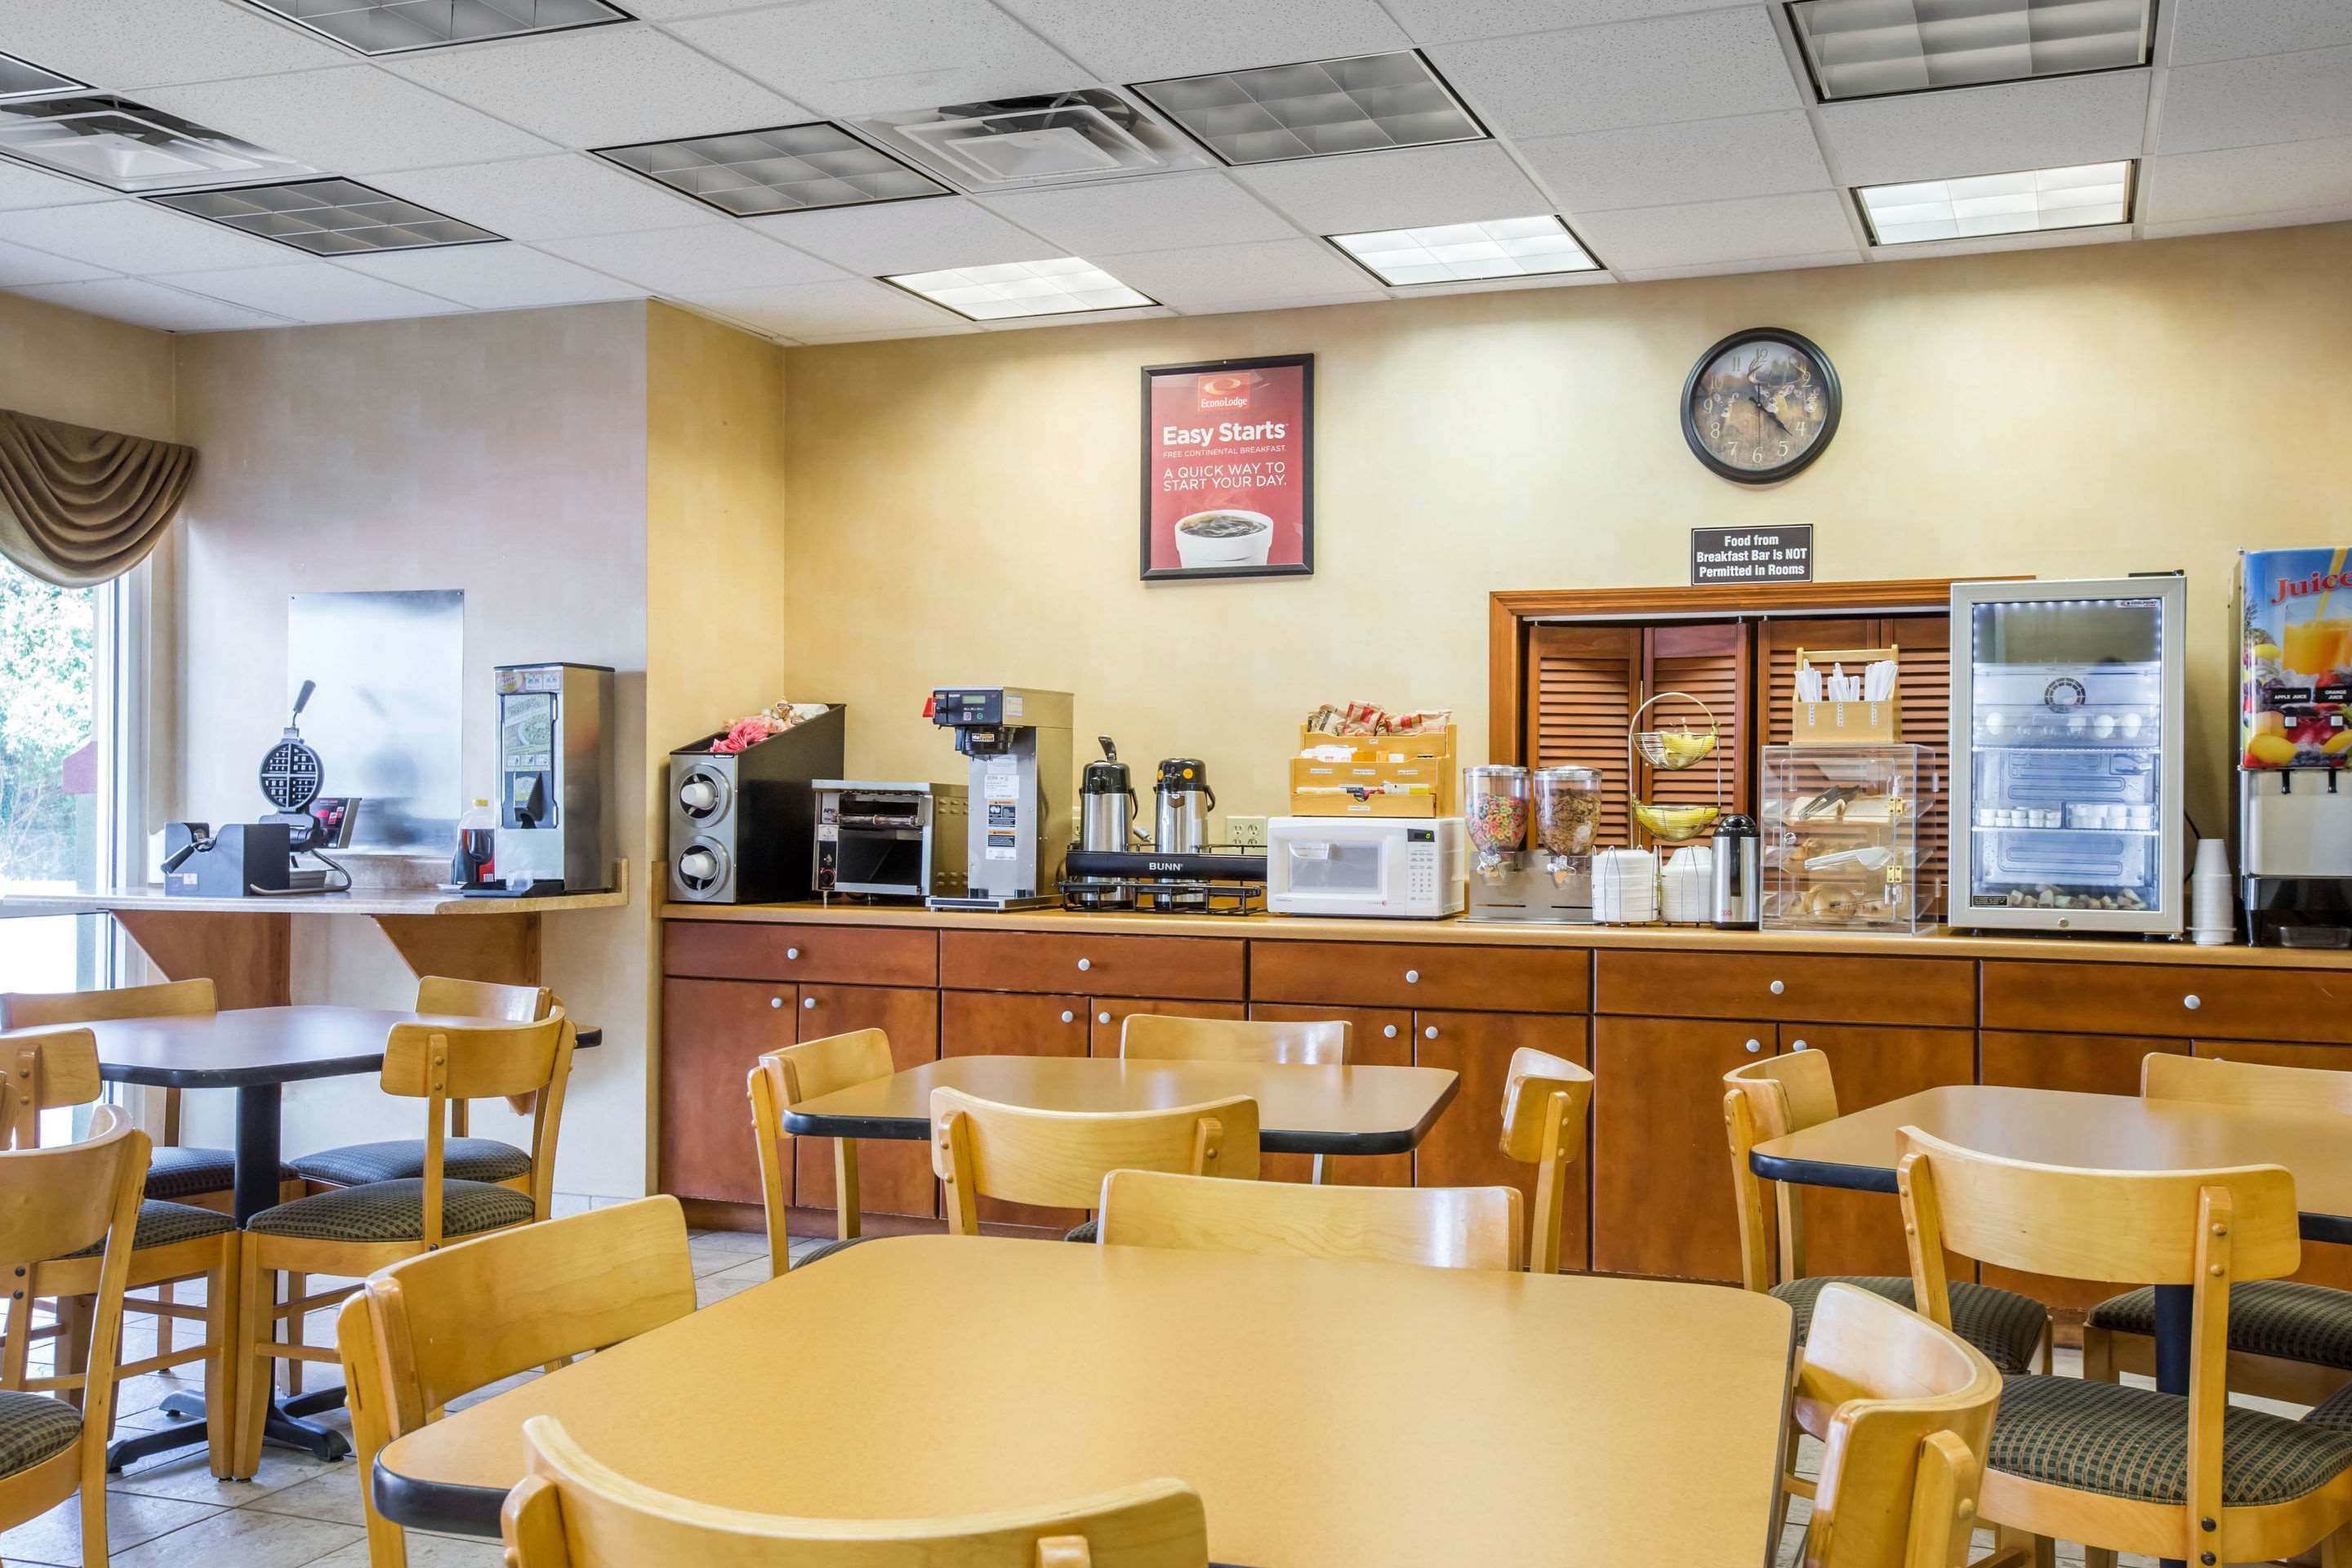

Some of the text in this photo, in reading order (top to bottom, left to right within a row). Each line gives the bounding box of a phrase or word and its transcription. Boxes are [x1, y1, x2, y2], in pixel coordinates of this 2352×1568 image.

[1756, 346, 1769, 361] 12
[1732, 356, 1740, 372] 11
[1711, 376, 1723, 390] 10
[1802, 372, 1813, 387] 2
[1704, 398, 1713, 413] 9
[1163, 421, 1285, 447] Easy Starts
[1710, 421, 1720, 439] 8
[1795, 421, 1807, 437] 4
[1163, 450, 1183, 458] FREE
[1184, 448, 1238, 458] CONTINENTAL
[1727, 441, 1739, 457] 7
[1753, 447, 1763, 464] 6
[1777, 440, 1790, 457] 5
[1164, 461, 1285, 479] A QUICK WAY TO
[1163, 474, 1287, 492] START YOUR DAY.
[1724, 534, 1780, 547] Food from
[1696, 548, 1807, 563] Breakfast Bar is NOT
[1699, 564, 1805, 577] Permitted in Rooms
[1149, 862, 1181, 871] BUNN
